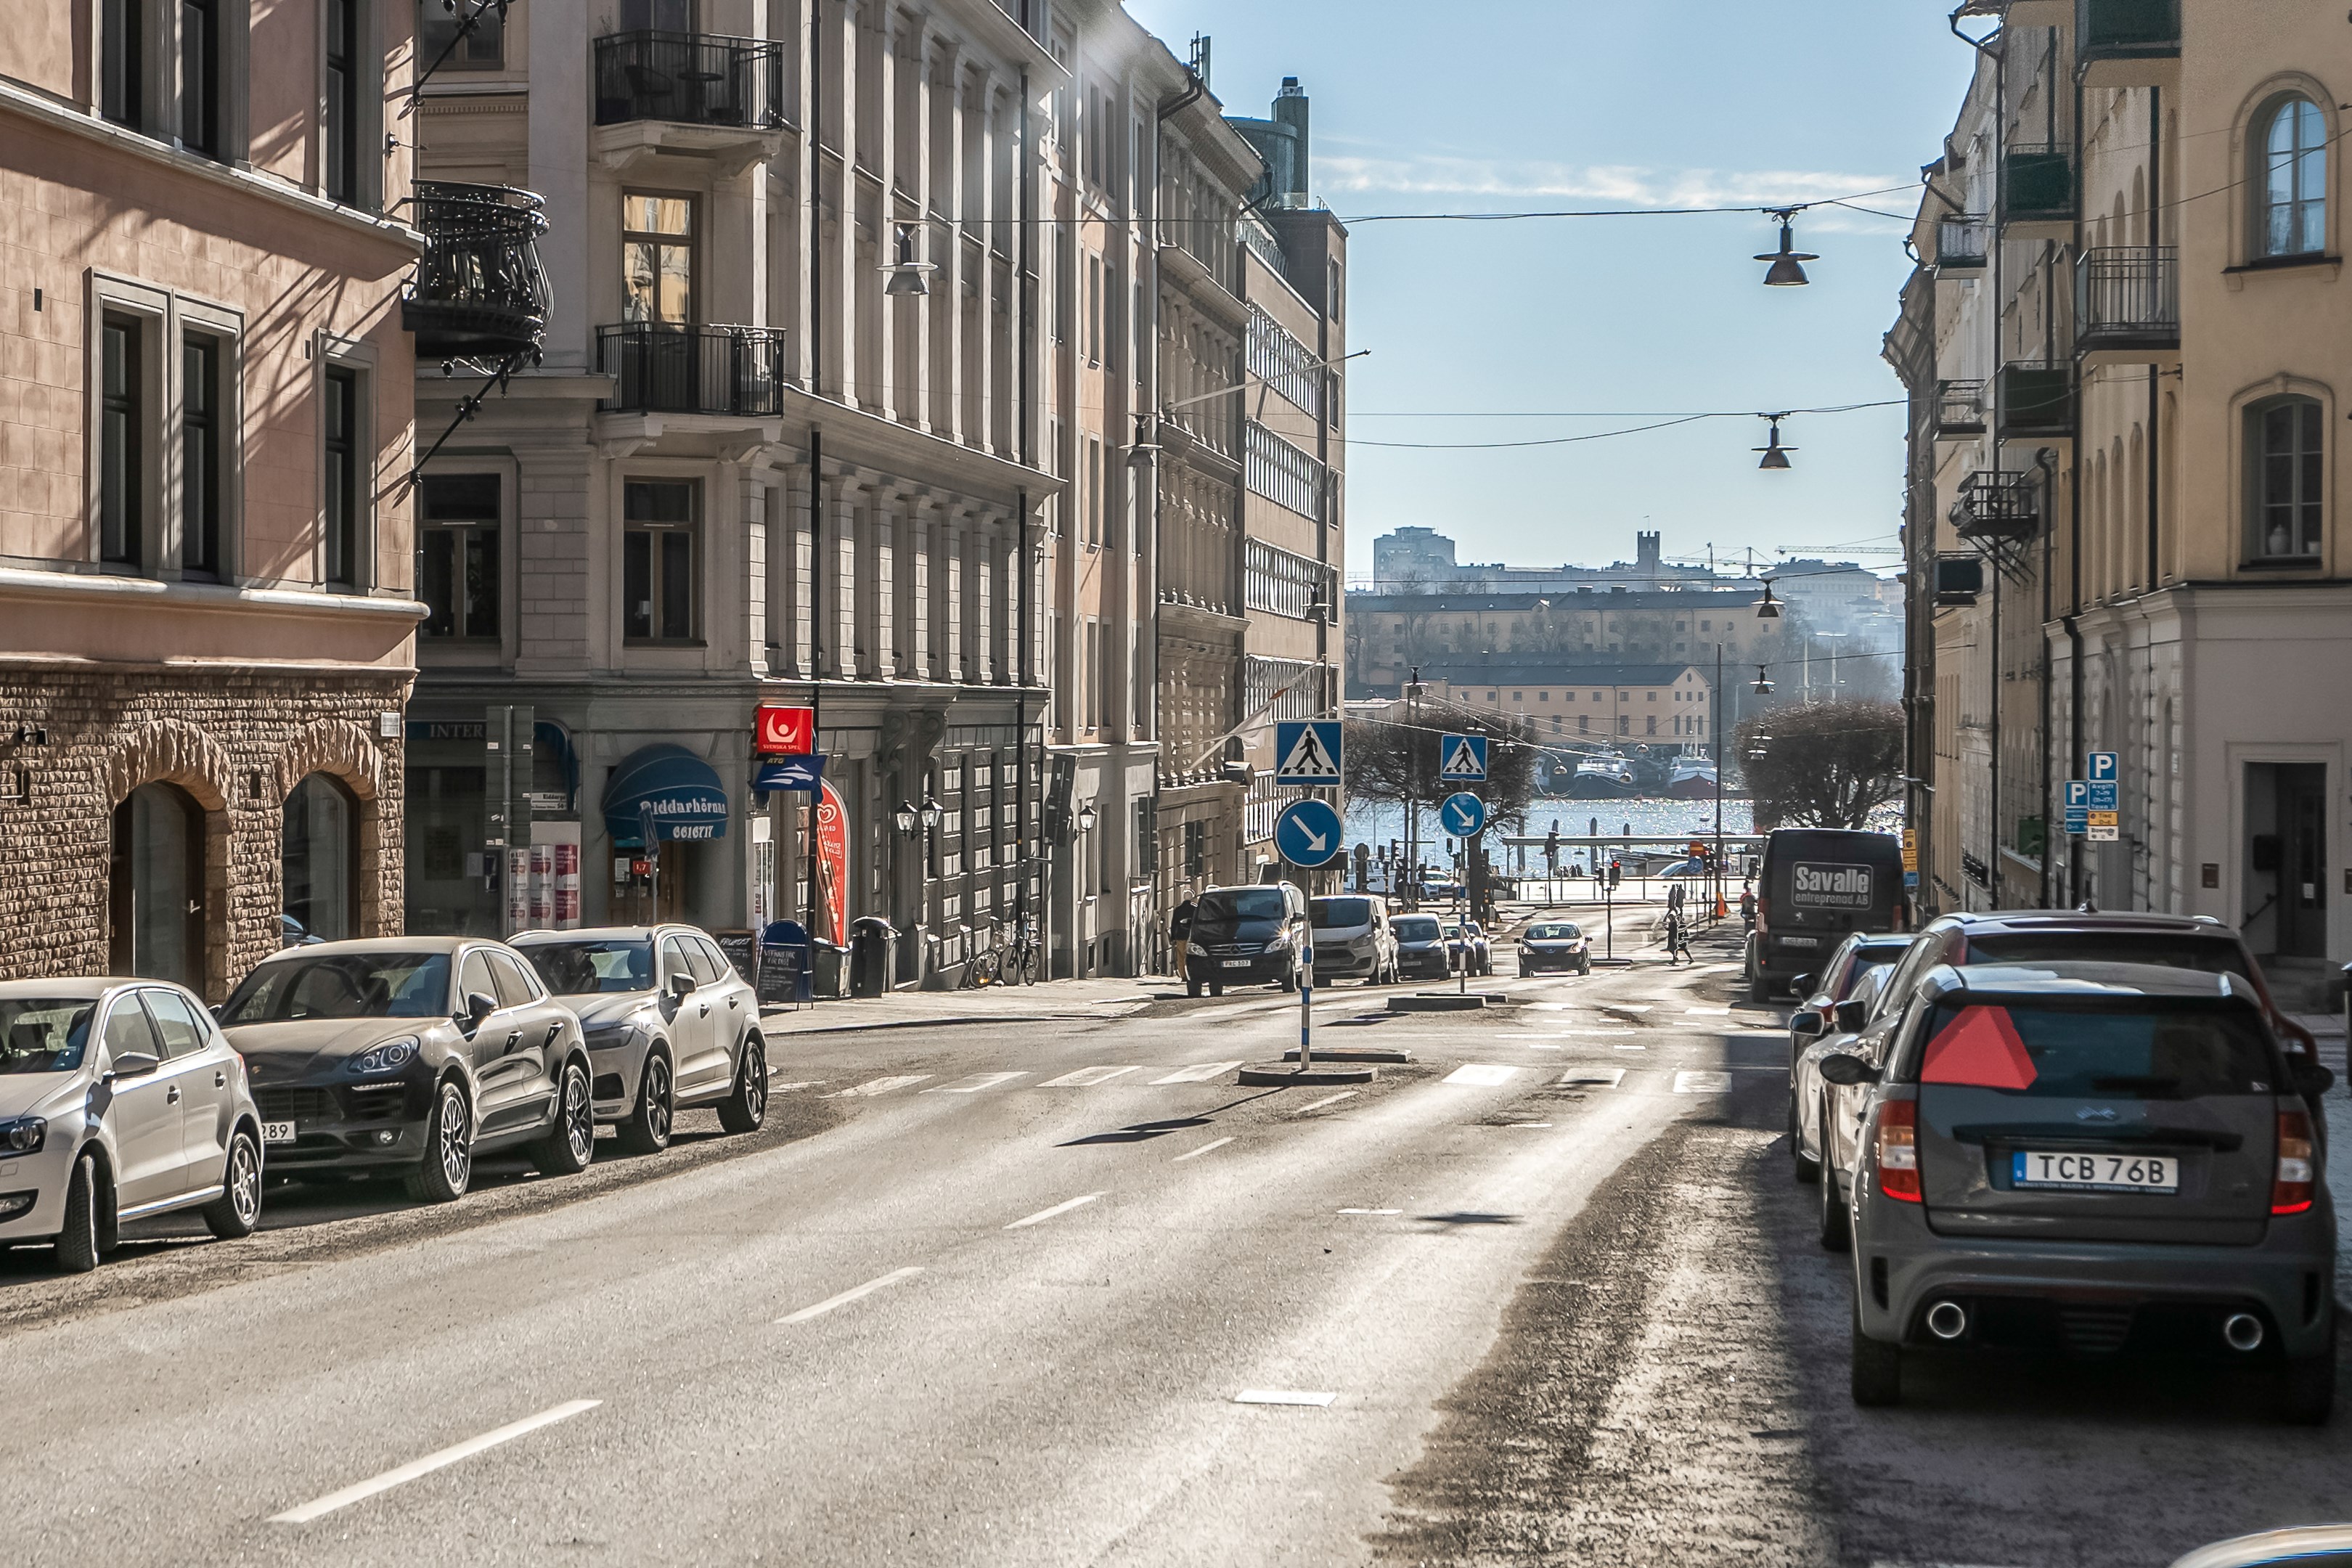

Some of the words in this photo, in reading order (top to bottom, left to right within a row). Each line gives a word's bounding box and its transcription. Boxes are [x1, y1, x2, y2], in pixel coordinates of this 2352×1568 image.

[2096, 755, 2112, 778] P
[2071, 783, 2086, 804] P
[1796, 867, 1869, 893] Savalle
[1855, 894, 1868, 905] AB
[2038, 1156, 2094, 1180] TCB
[2107, 1158, 2164, 1184] 76B
